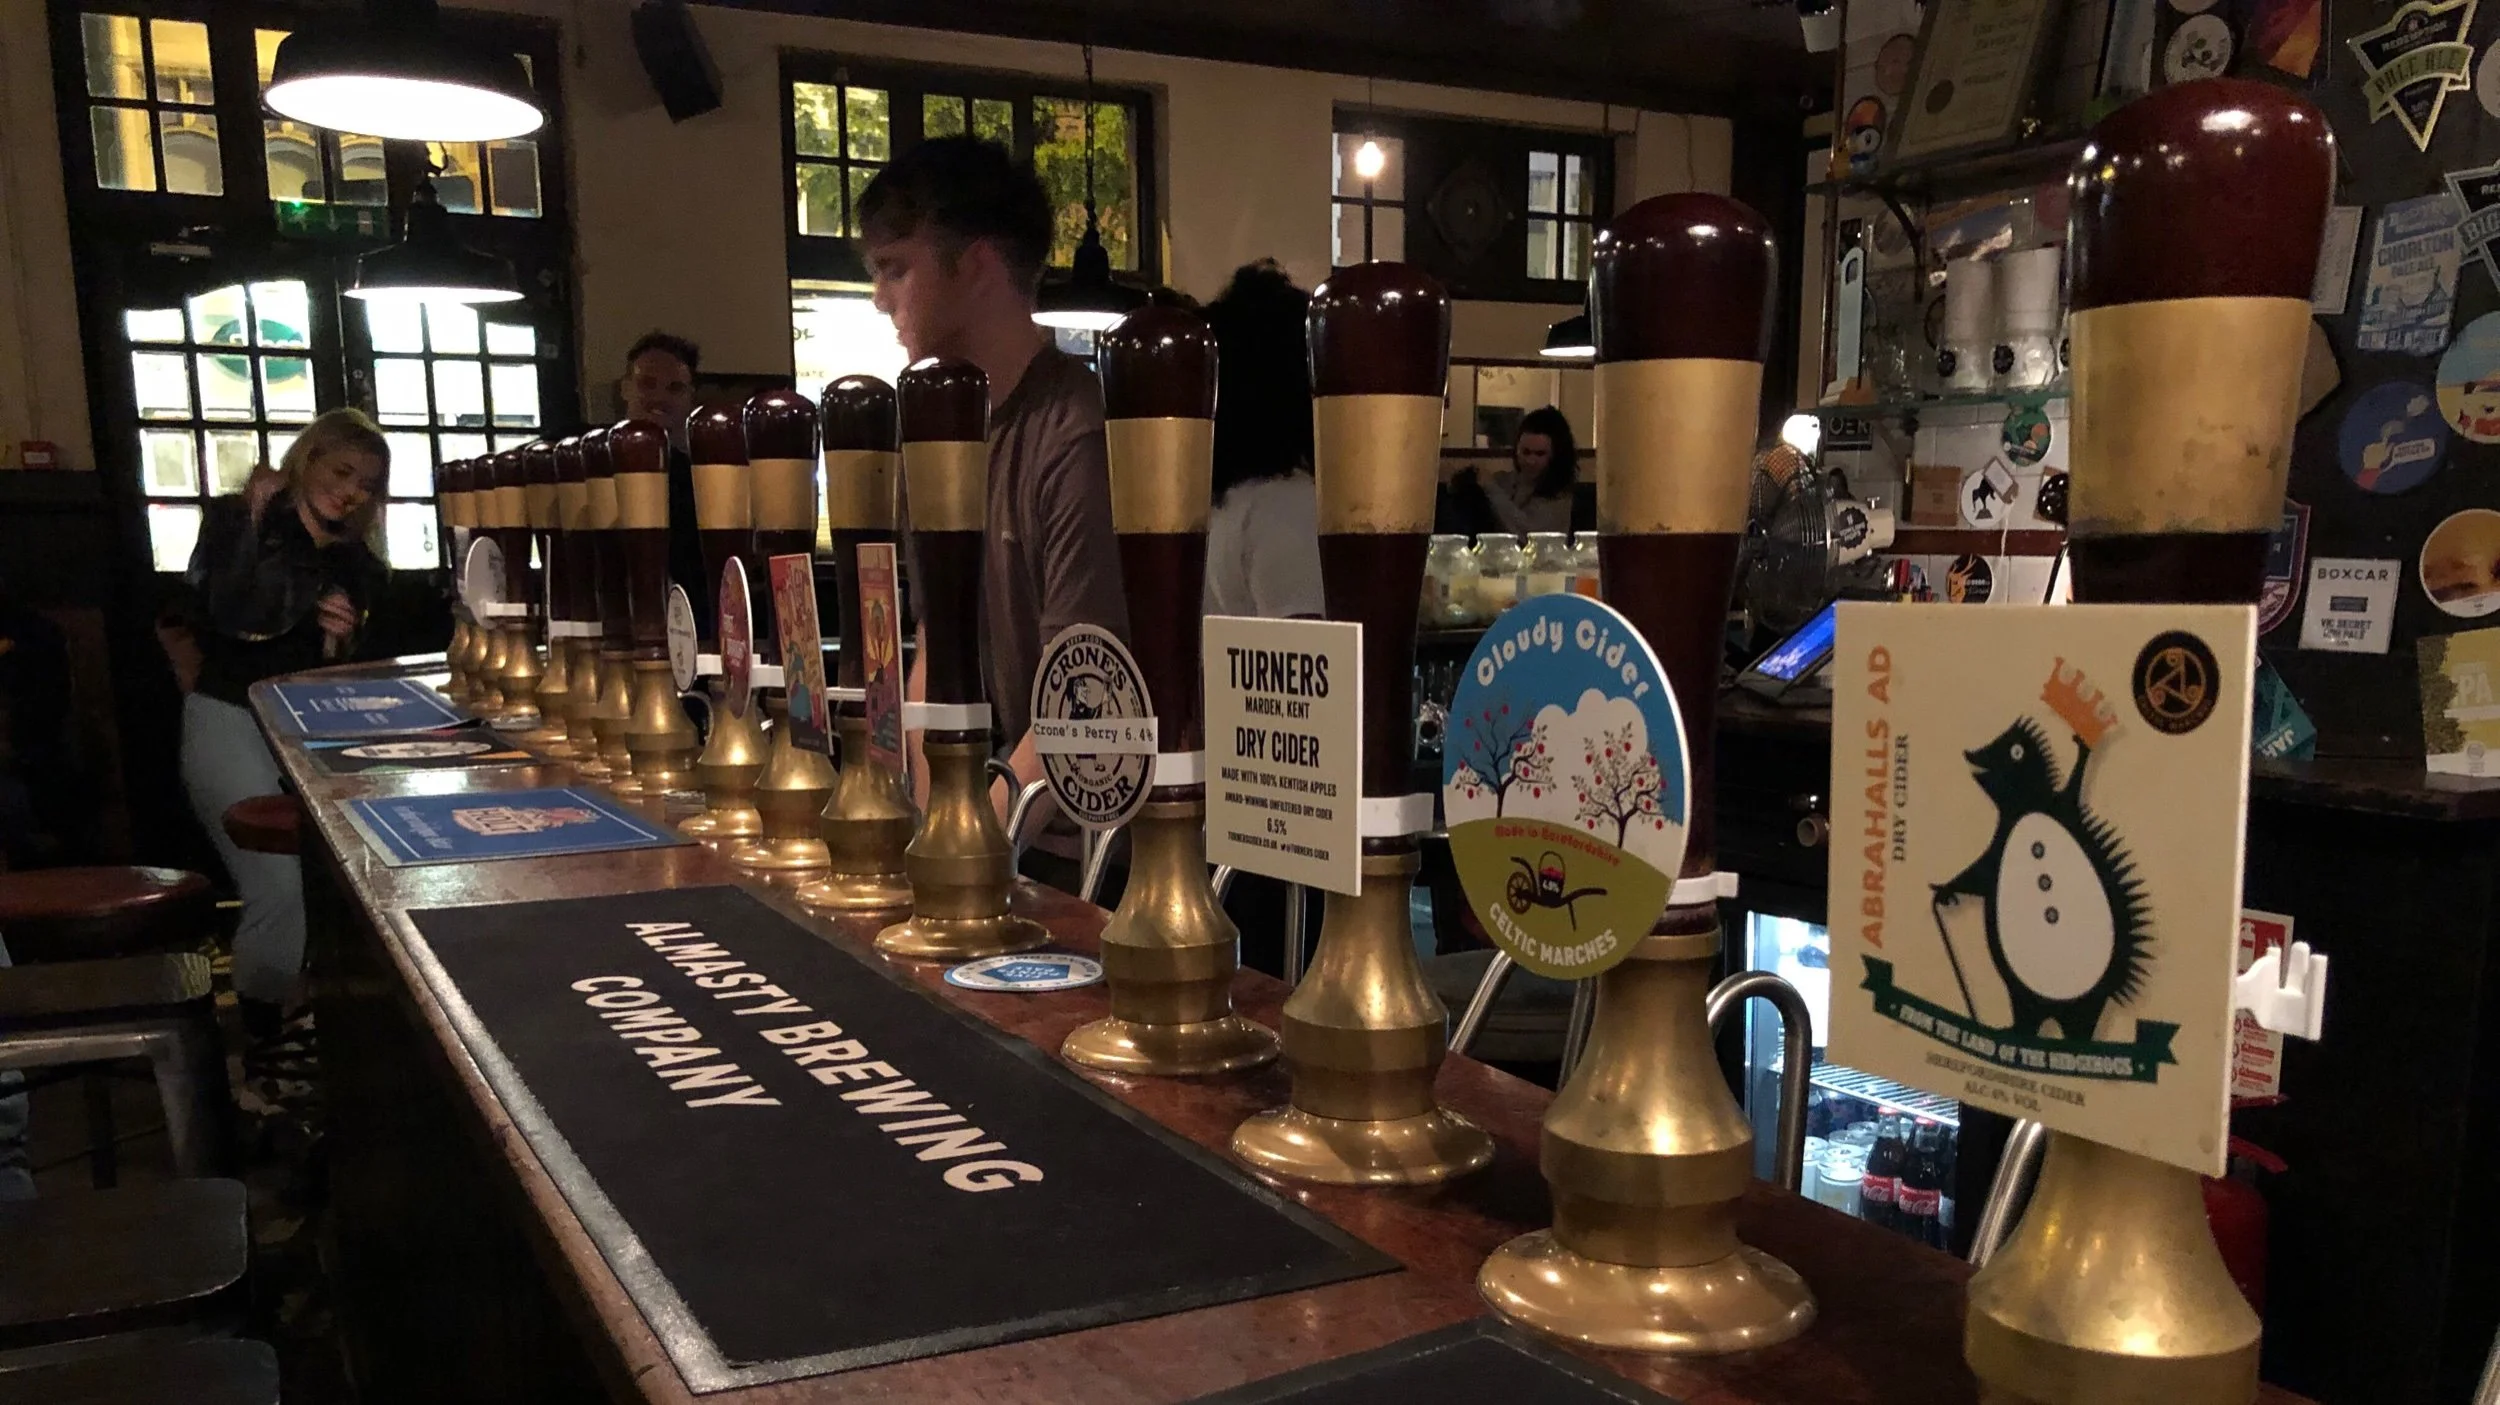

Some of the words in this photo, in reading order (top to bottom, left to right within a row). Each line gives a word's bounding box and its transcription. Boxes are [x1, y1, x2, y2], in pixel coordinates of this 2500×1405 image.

[2375, 56, 2418, 94] PALE
[2425, 48, 2461, 71] ALE
[2318, 568, 2388, 581] BOXCAR
[2337, 619, 2373, 630] SECRET
[1050, 646, 1126, 692] CRONE'S
[1227, 647, 1329, 698] TURNERS
[1477, 615, 1563, 686] Cloudy
[1576, 619, 1649, 699] Cider
[1867, 645, 1891, 704] AD
[1245, 696, 1284, 718] MARDEN,
[1287, 701, 1310, 719] KENT
[1034, 723, 1078, 738] Crone's
[1085, 726, 1118, 743] Perry
[1125, 727, 1154, 742] 6.4%
[1237, 726, 1266, 760] DRY
[1272, 731, 1320, 768] CIDER
[1078, 774, 1112, 786] ORGANIC
[1222, 767, 1239, 781] MADE
[1242, 770, 1259, 784] WITH
[1260, 774, 1277, 788] 100%
[1279, 777, 1308, 792] KENTISH
[1310, 781, 1337, 797] APPLES
[1893, 732, 1909, 808] CIDER
[1063, 775, 1134, 812] CIDER
[1270, 799, 1302, 815] UNFILTERED
[1303, 804, 1314, 816] DRY
[1315, 807, 1333, 821] CIDER
[1267, 818, 1287, 835] 6.5%
[1862, 717, 1890, 949] ABRAHALLS
[1893, 814, 1908, 861] DRY
[1489, 902, 1537, 957] CELTIC
[1540, 928, 1618, 966] MARCHES
[570, 975, 783, 1109] COMPANY
[625, 921, 813, 1017] ALMASTY
[759, 1020, 1044, 1193] BREWING
[1899, 1004, 1934, 1032] FROM
[1935, 1019, 1961, 1042] THE
[1961, 1030, 1997, 1056] LAND
[1998, 1044, 2018, 1063] OF
[2019, 1048, 2046, 1067] THE
[1926, 1052, 2038, 1093] HEREFORDSHIRE
[2040, 1083, 2085, 1107] CIDER
